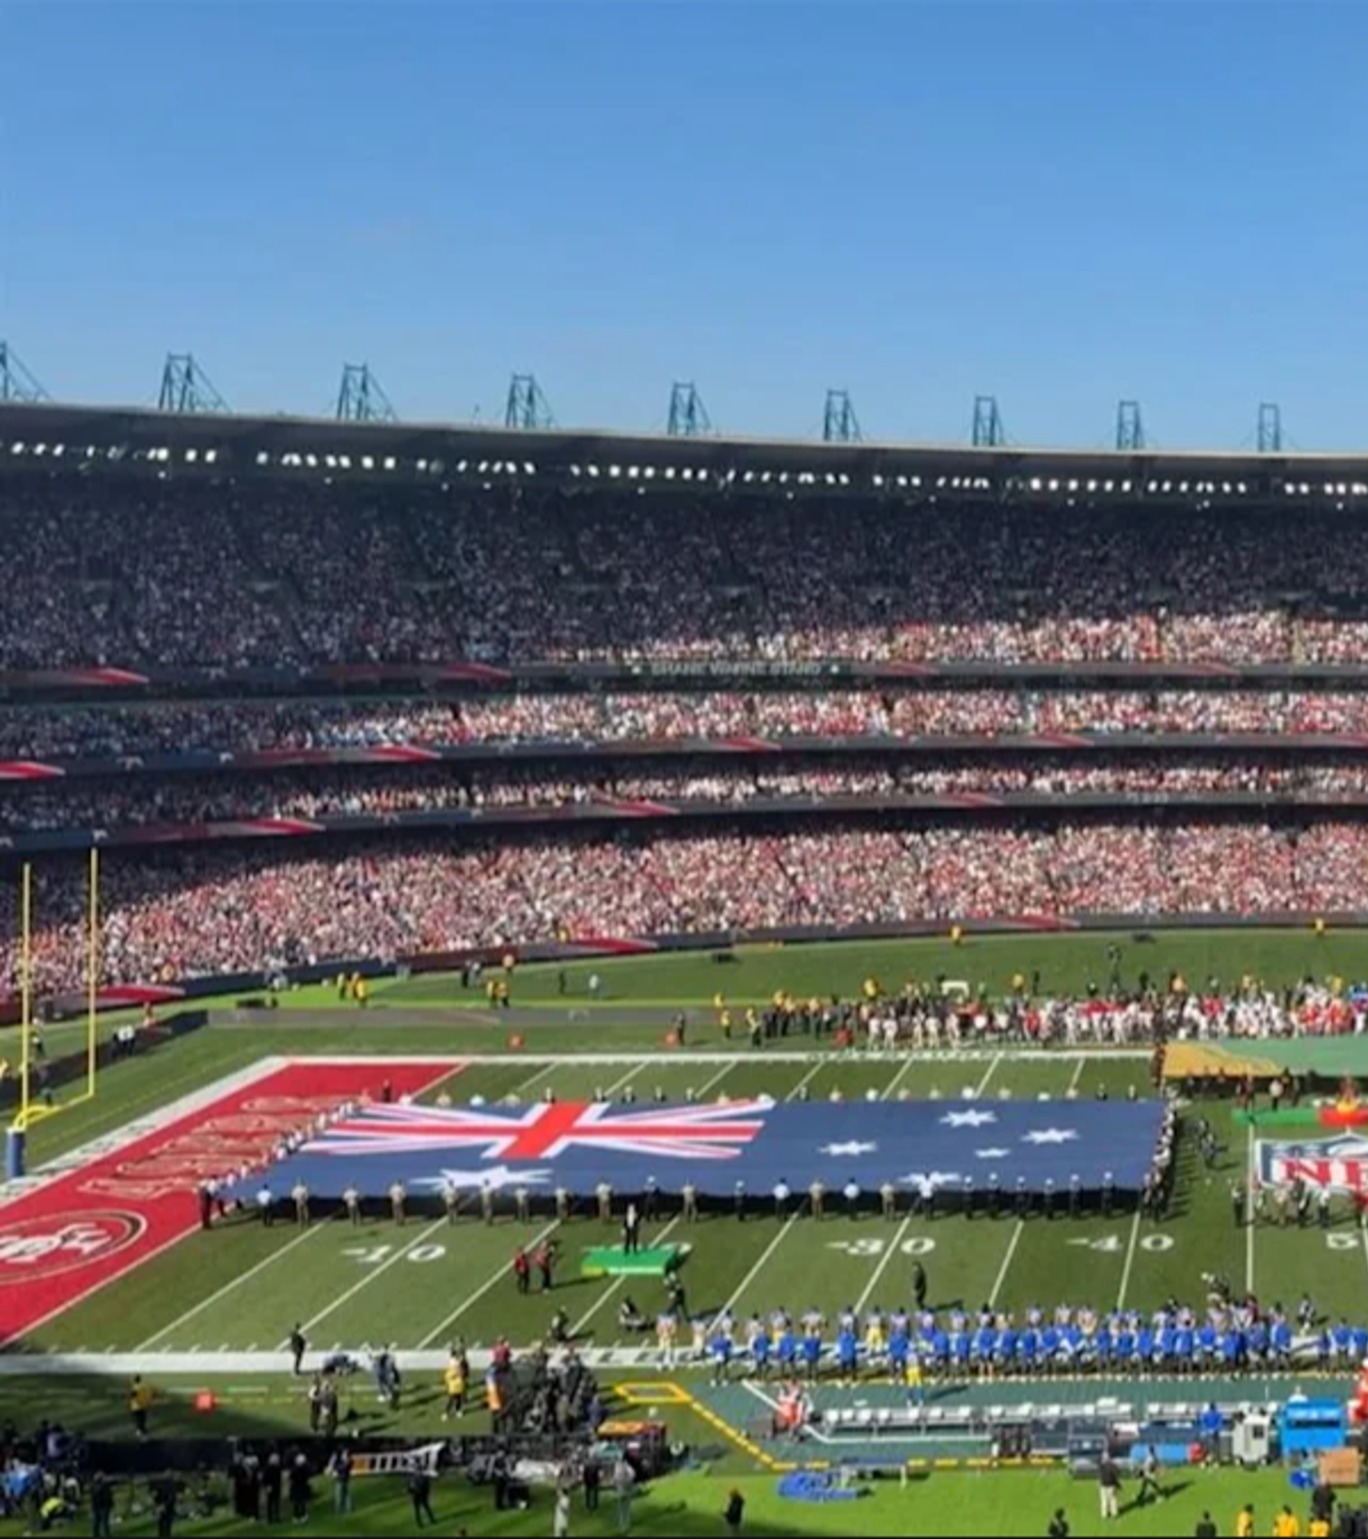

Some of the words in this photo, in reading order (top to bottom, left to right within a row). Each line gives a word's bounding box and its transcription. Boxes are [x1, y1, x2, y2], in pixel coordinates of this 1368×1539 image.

[847, 1237, 936, 1255] 30
[1089, 1234, 1175, 1251] 40
[356, 1244, 447, 1263] 10
